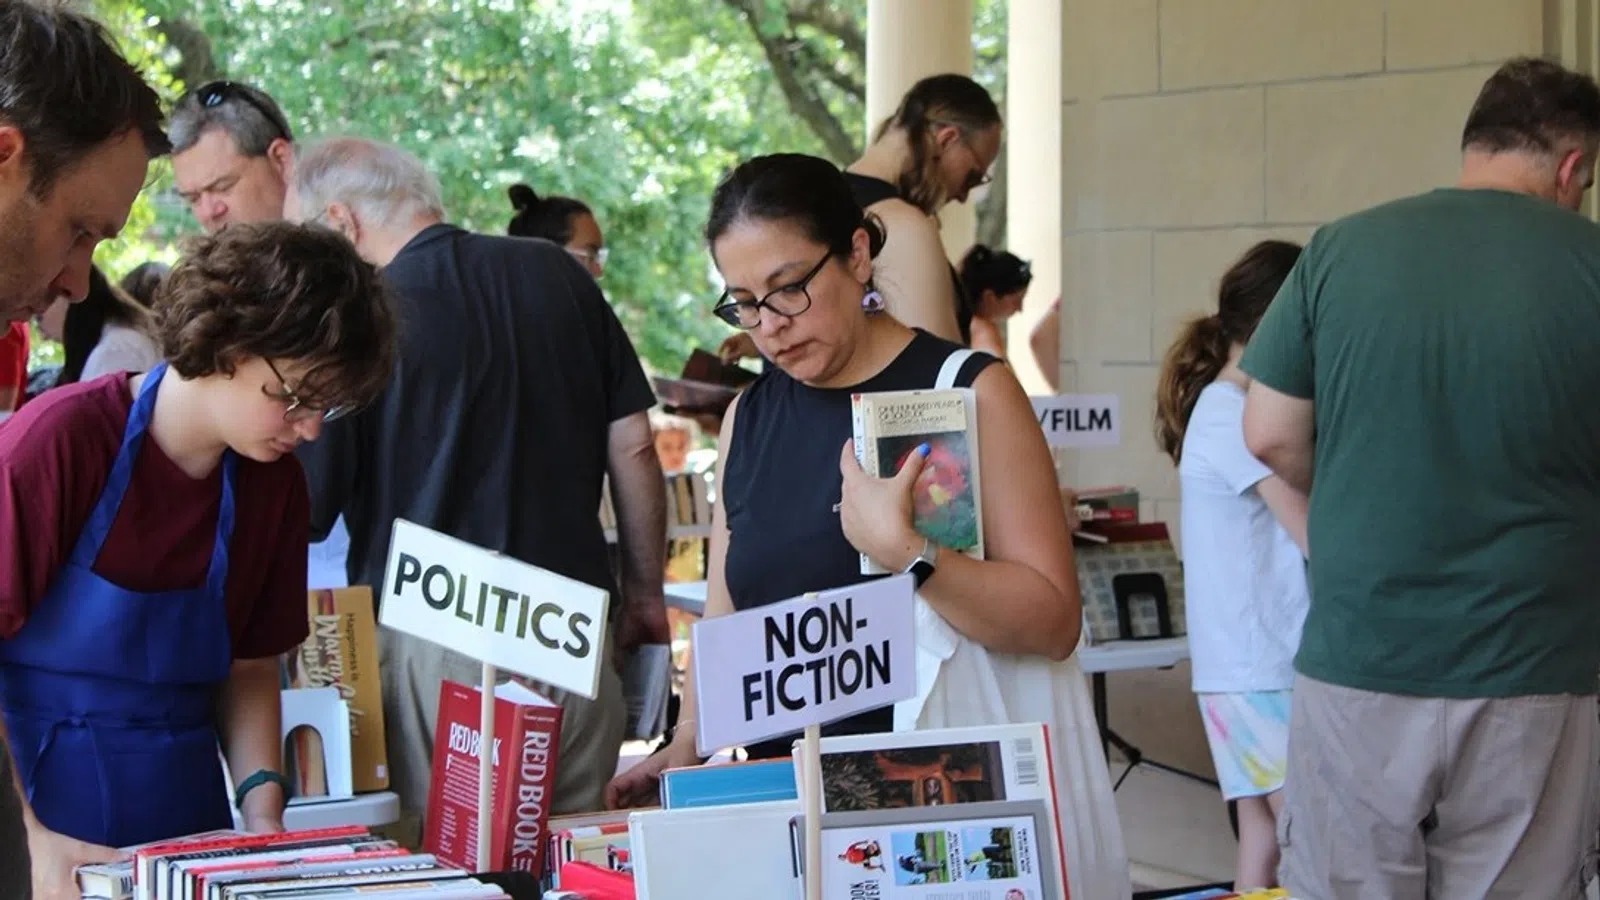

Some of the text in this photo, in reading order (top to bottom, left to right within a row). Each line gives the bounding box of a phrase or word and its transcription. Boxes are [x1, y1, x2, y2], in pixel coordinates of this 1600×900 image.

[393, 552, 592, 658] POLITICS
[764, 598, 867, 662] NON-
[314, 614, 343, 676] Warm
[345, 612, 358, 670] Happiness
[742, 640, 891, 721] FICTION
[448, 721, 502, 766] RED BK
[521, 730, 552, 782] RED
[512, 785, 545, 856] BOOK
